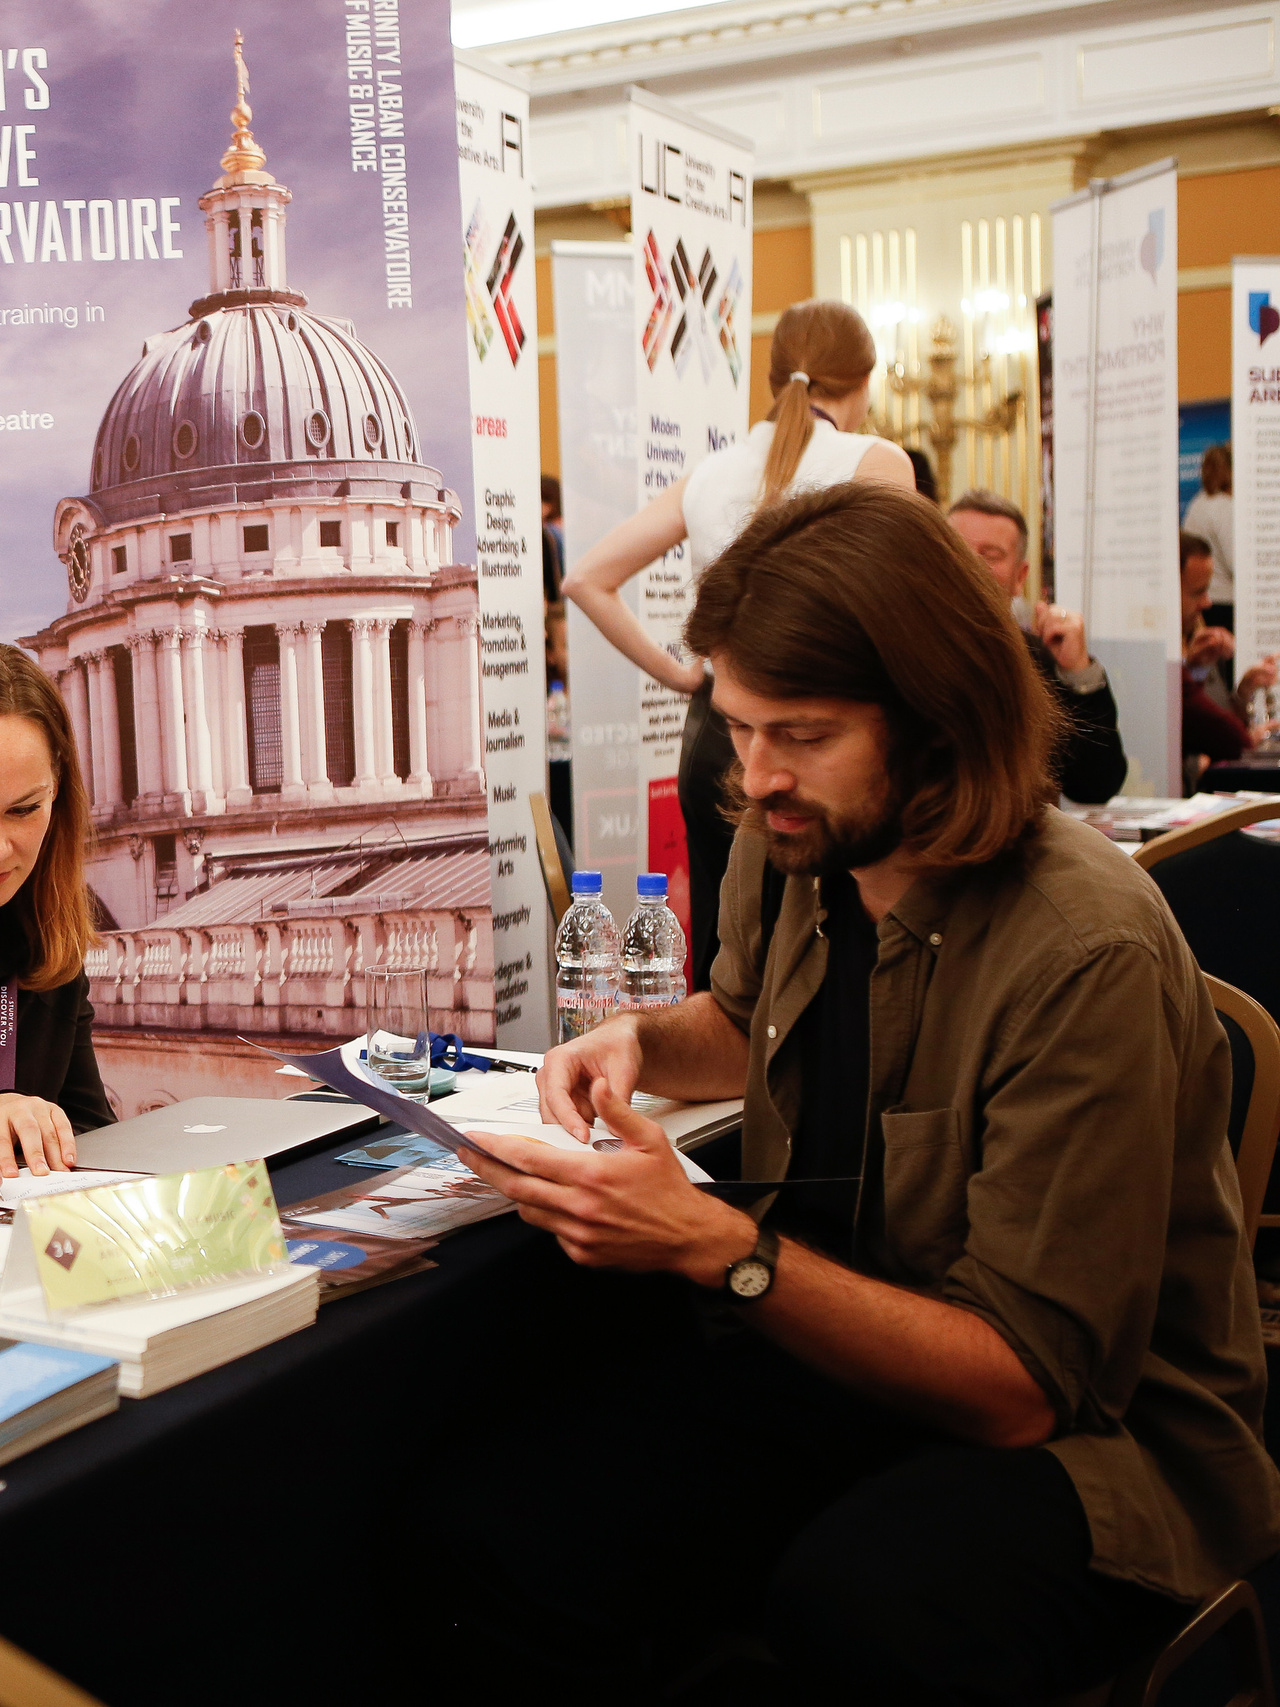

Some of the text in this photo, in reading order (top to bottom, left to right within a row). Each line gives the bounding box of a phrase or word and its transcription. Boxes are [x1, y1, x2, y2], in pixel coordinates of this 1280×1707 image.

[346, 14, 373, 80] MUSIC
[348, 84, 374, 99] &
[377, 70, 404, 137] LABAN
[349, 104, 377, 172] DANCE
[380, 144, 412, 309] CONSERVATOIRE
[85, 301, 106, 322] in
[476, 415, 508, 438] areas
[650, 414, 681, 437] Modern
[646, 441, 686, 468] University
[485, 488, 516, 511] Graphic
[521, 536, 528, 555] &
[482, 560, 523, 578] Illustration
[481, 633, 527, 653] Promotion &
[488, 707, 520, 729] Media &
[485, 731, 526, 754] Journalism
[493, 782, 517, 804] Music
[498, 858, 514, 878] Arts
[0, 985, 8, 1047] DISCOVER YOU
